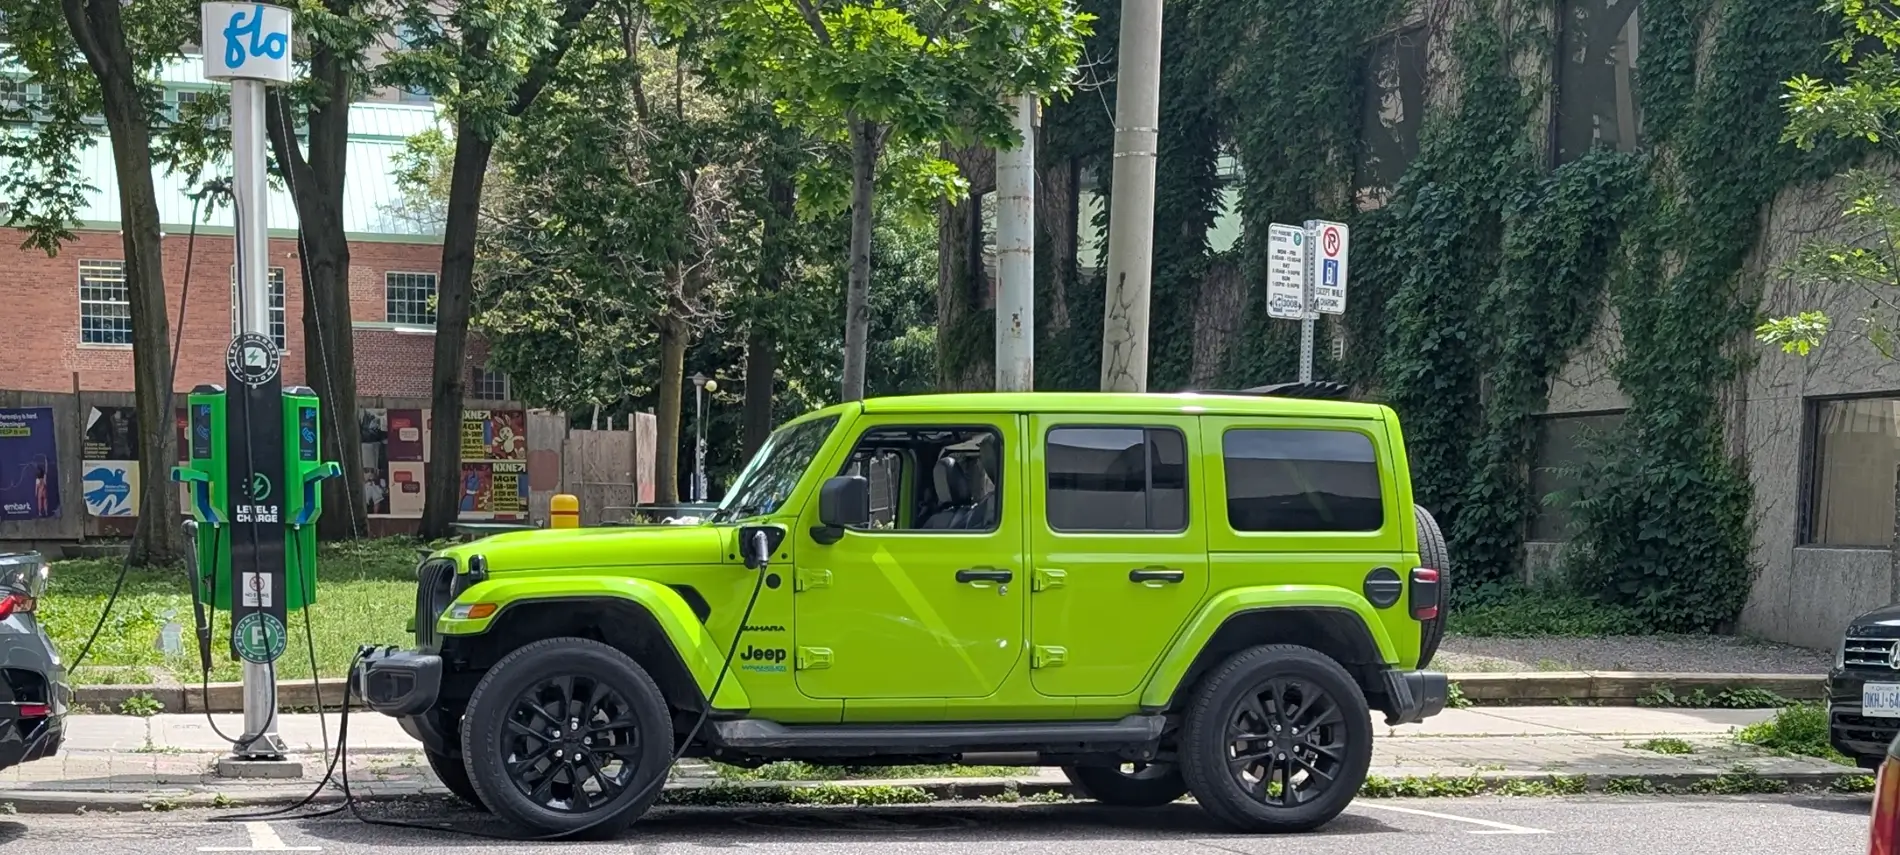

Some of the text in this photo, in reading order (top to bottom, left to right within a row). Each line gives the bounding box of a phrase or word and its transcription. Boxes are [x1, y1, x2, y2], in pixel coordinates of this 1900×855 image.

[223, 4, 288, 69] flo
[1315, 287, 1344, 298] EXCEPT WHILE
[1319, 299, 1339, 308] CHARGING
[493, 463, 517, 473] NXNE
[494, 475, 517, 483] MGK
[4, 502, 31, 511] embark
[236, 504, 278, 514] LEVEL 2
[236, 514, 278, 523] CHARGE
[237, 641, 283, 661] PARKNG
[740, 645, 787, 664] Jeep
